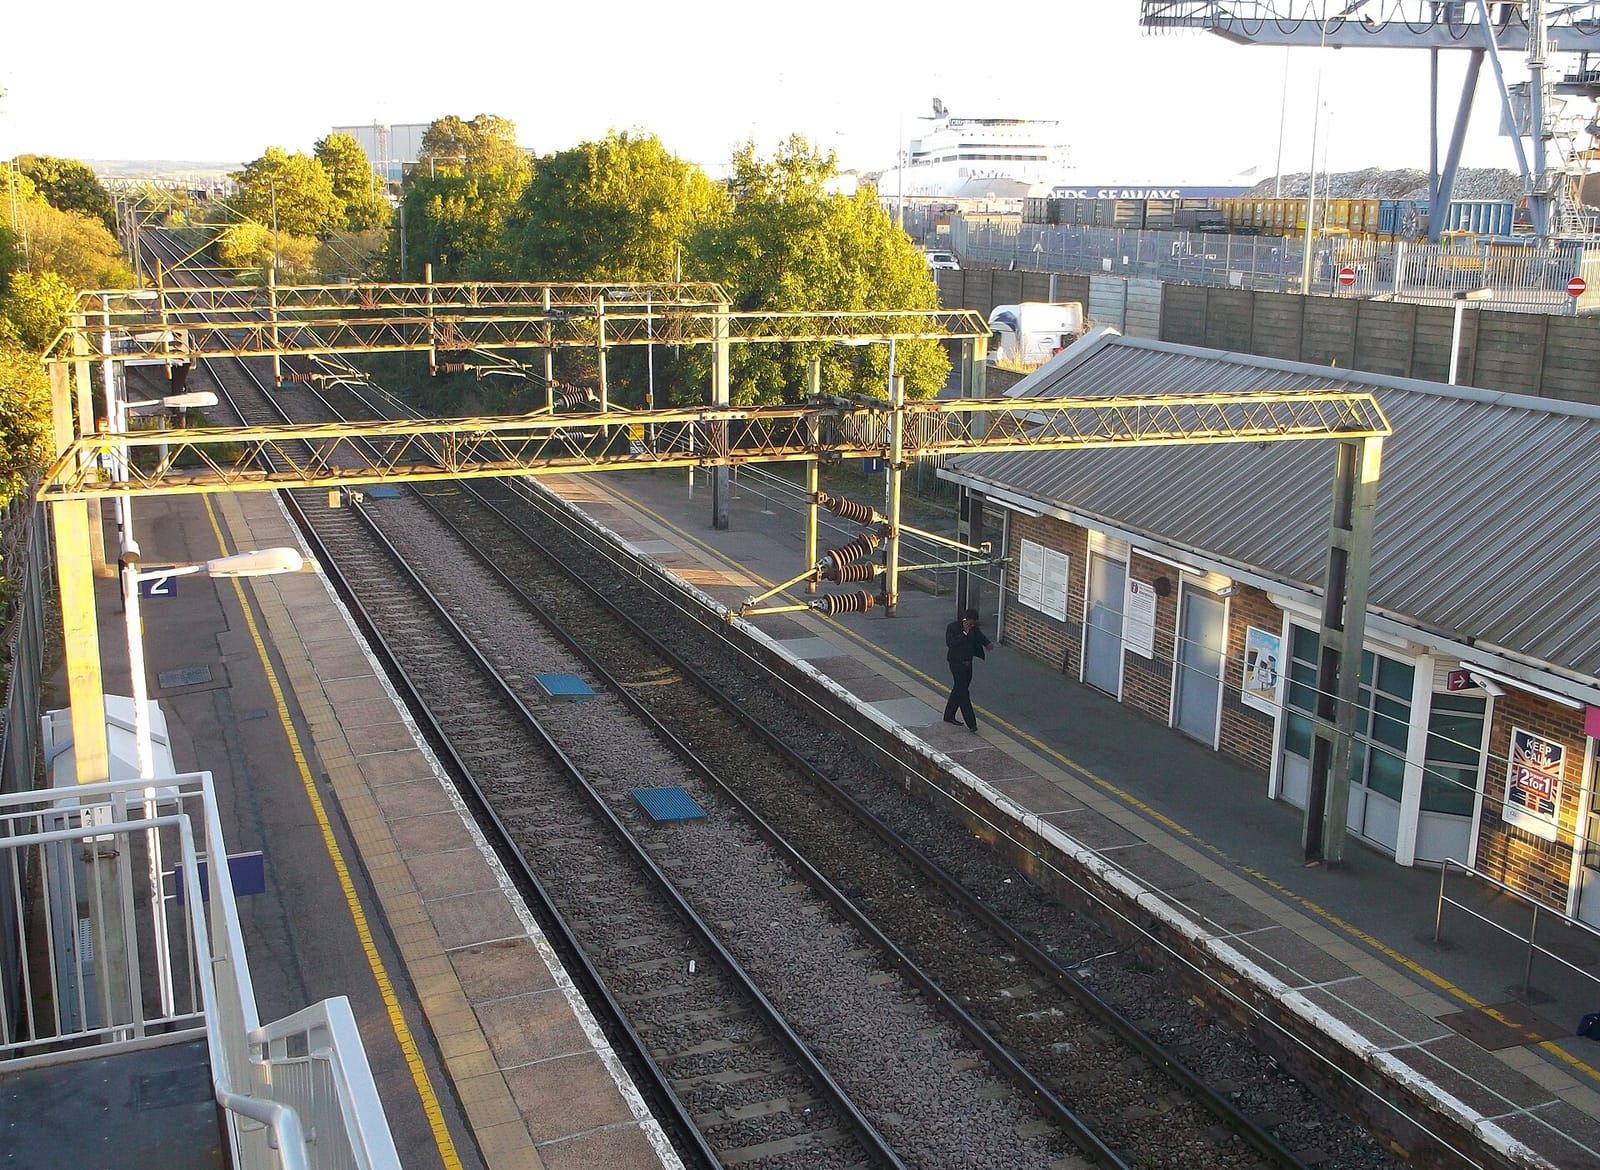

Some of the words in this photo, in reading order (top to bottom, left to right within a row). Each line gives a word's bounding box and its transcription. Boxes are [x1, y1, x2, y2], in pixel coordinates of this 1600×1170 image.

[1097, 189, 1181, 200] SEAWAYS
[150, 576, 169, 595] 2
[1526, 738, 1552, 755] KEEP
[1524, 749, 1552, 767] CALM
